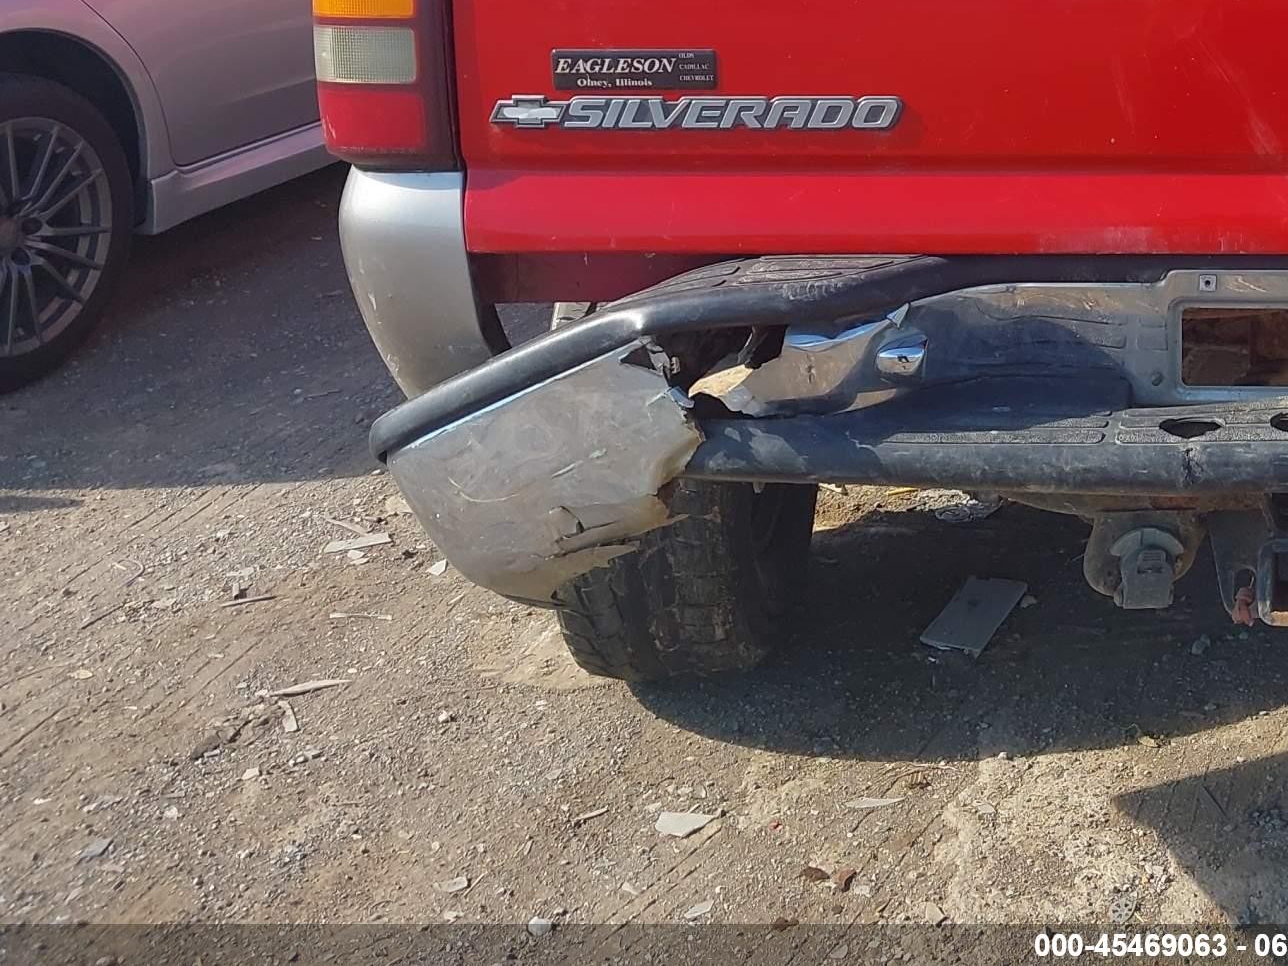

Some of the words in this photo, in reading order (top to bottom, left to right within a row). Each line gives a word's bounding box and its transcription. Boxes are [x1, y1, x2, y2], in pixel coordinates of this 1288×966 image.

[555, 58, 677, 74] EAGLESON
[577, 77, 612, 88] Olney,
[616, 78, 653, 87] Illinois
[563, 97, 901, 129] SILVERADO
